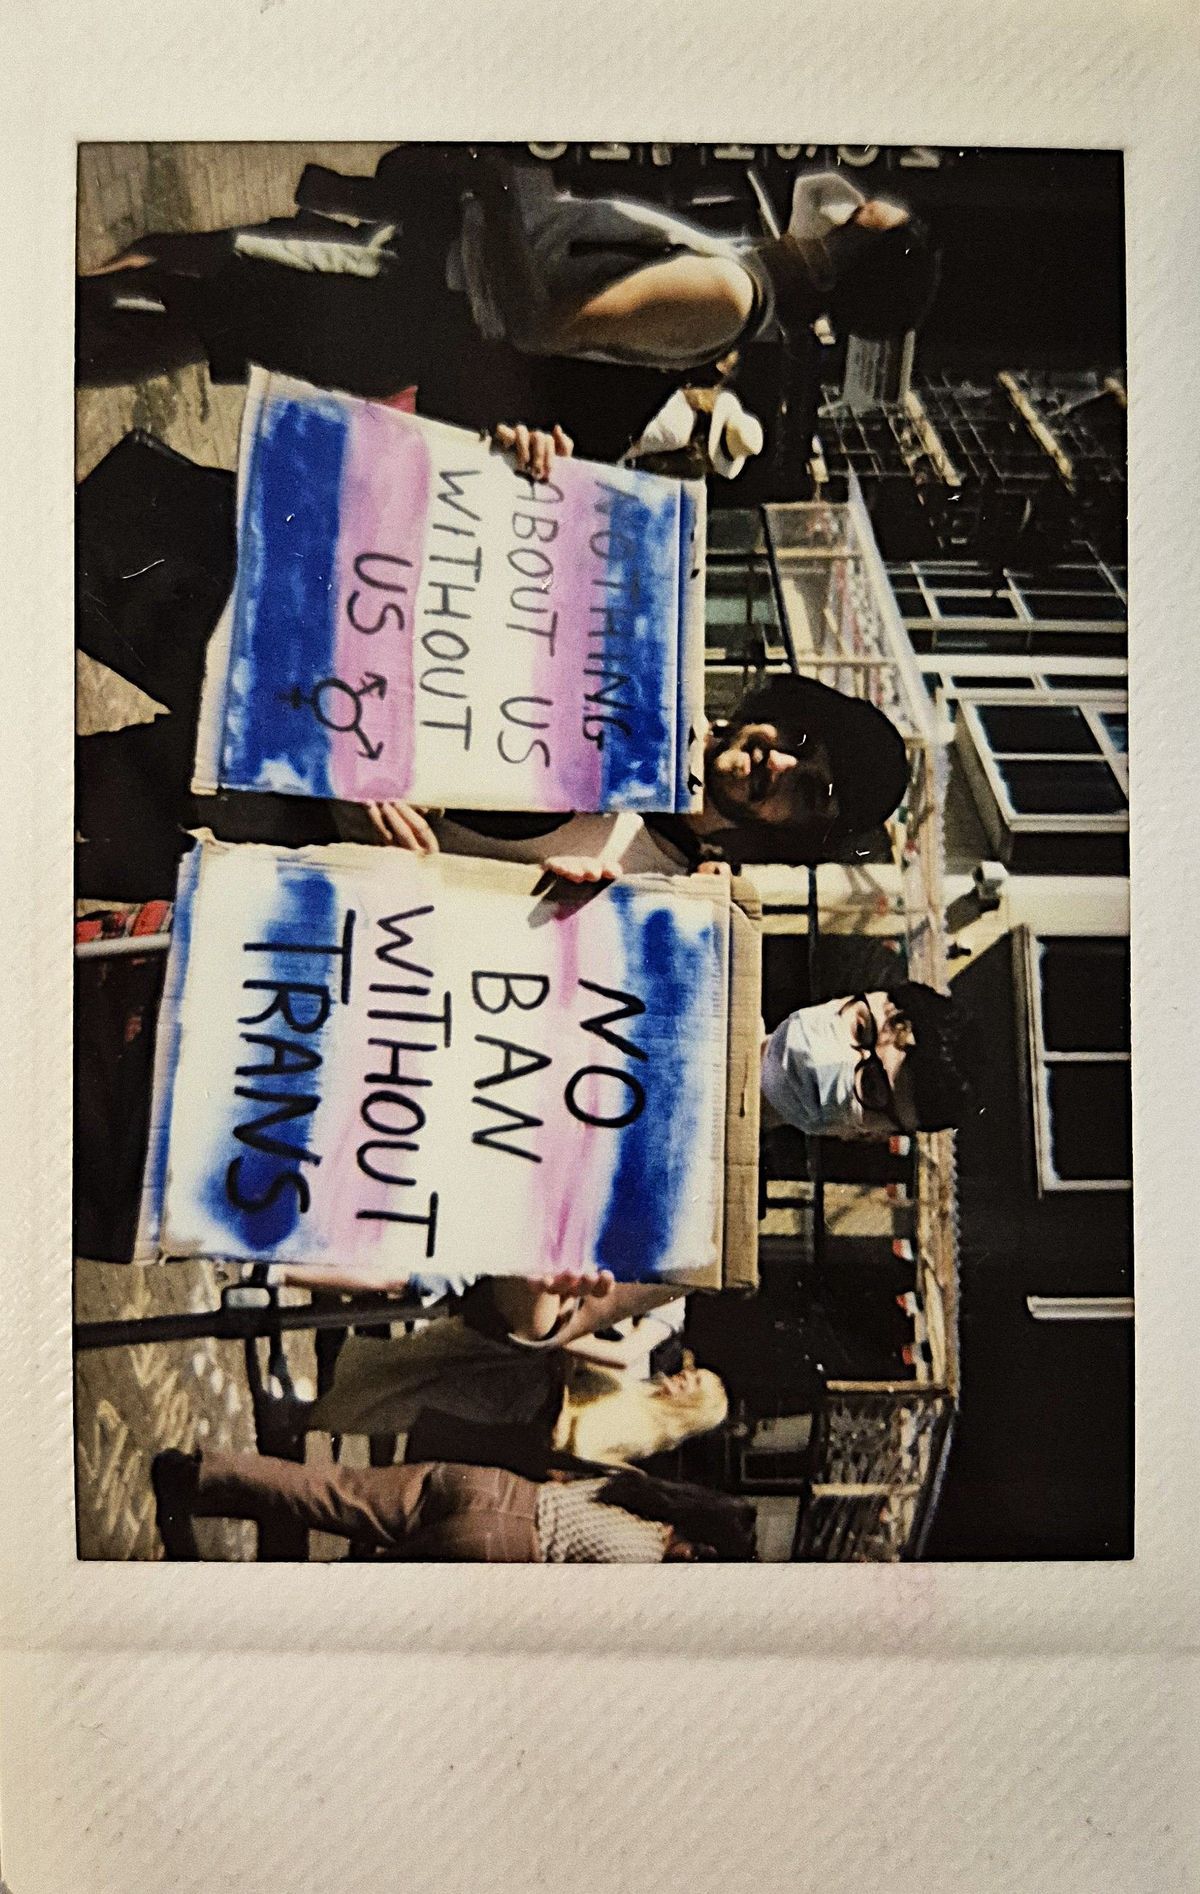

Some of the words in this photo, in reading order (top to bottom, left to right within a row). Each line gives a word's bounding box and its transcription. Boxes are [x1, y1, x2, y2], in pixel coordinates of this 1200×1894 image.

[347, 552, 413, 635] US
[419, 469, 483, 752] WITHOUT
[507, 481, 564, 656] ABOUT
[582, 481, 643, 752] NOTHING
[497, 696, 553, 768] US
[225, 909, 356, 1214] TRANS
[356, 905, 451, 1258] WITHOUT
[472, 970, 552, 1163] BAN
[564, 978, 649, 1129] NO
